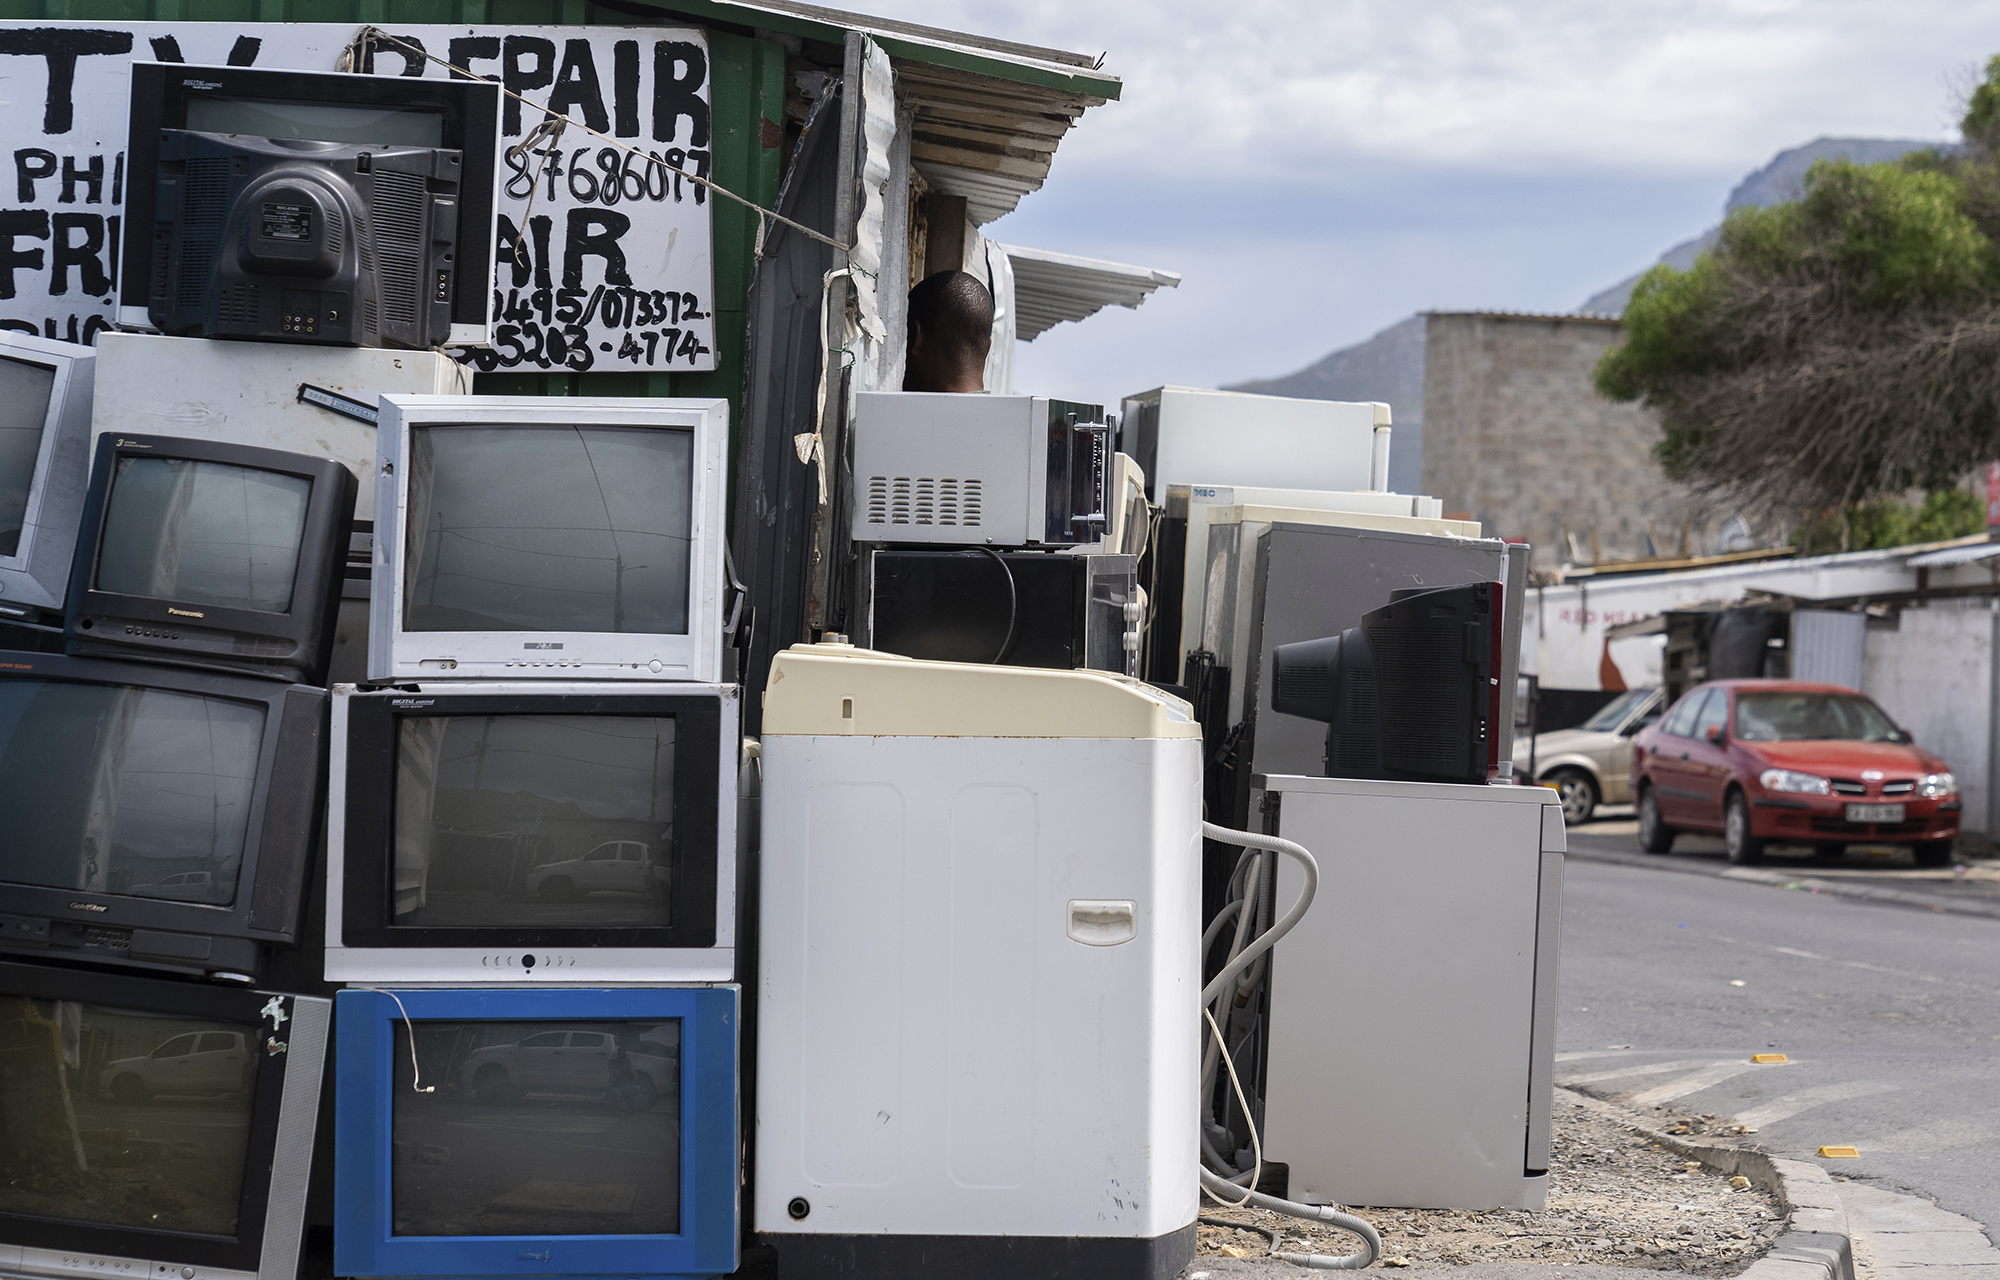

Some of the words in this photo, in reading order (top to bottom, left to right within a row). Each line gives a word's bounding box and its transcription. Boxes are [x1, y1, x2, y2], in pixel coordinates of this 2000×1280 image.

[115, 438, 125, 447] 3
[168, 607, 204, 618] Panasonic
[70, 902, 108, 912] GoldStar
